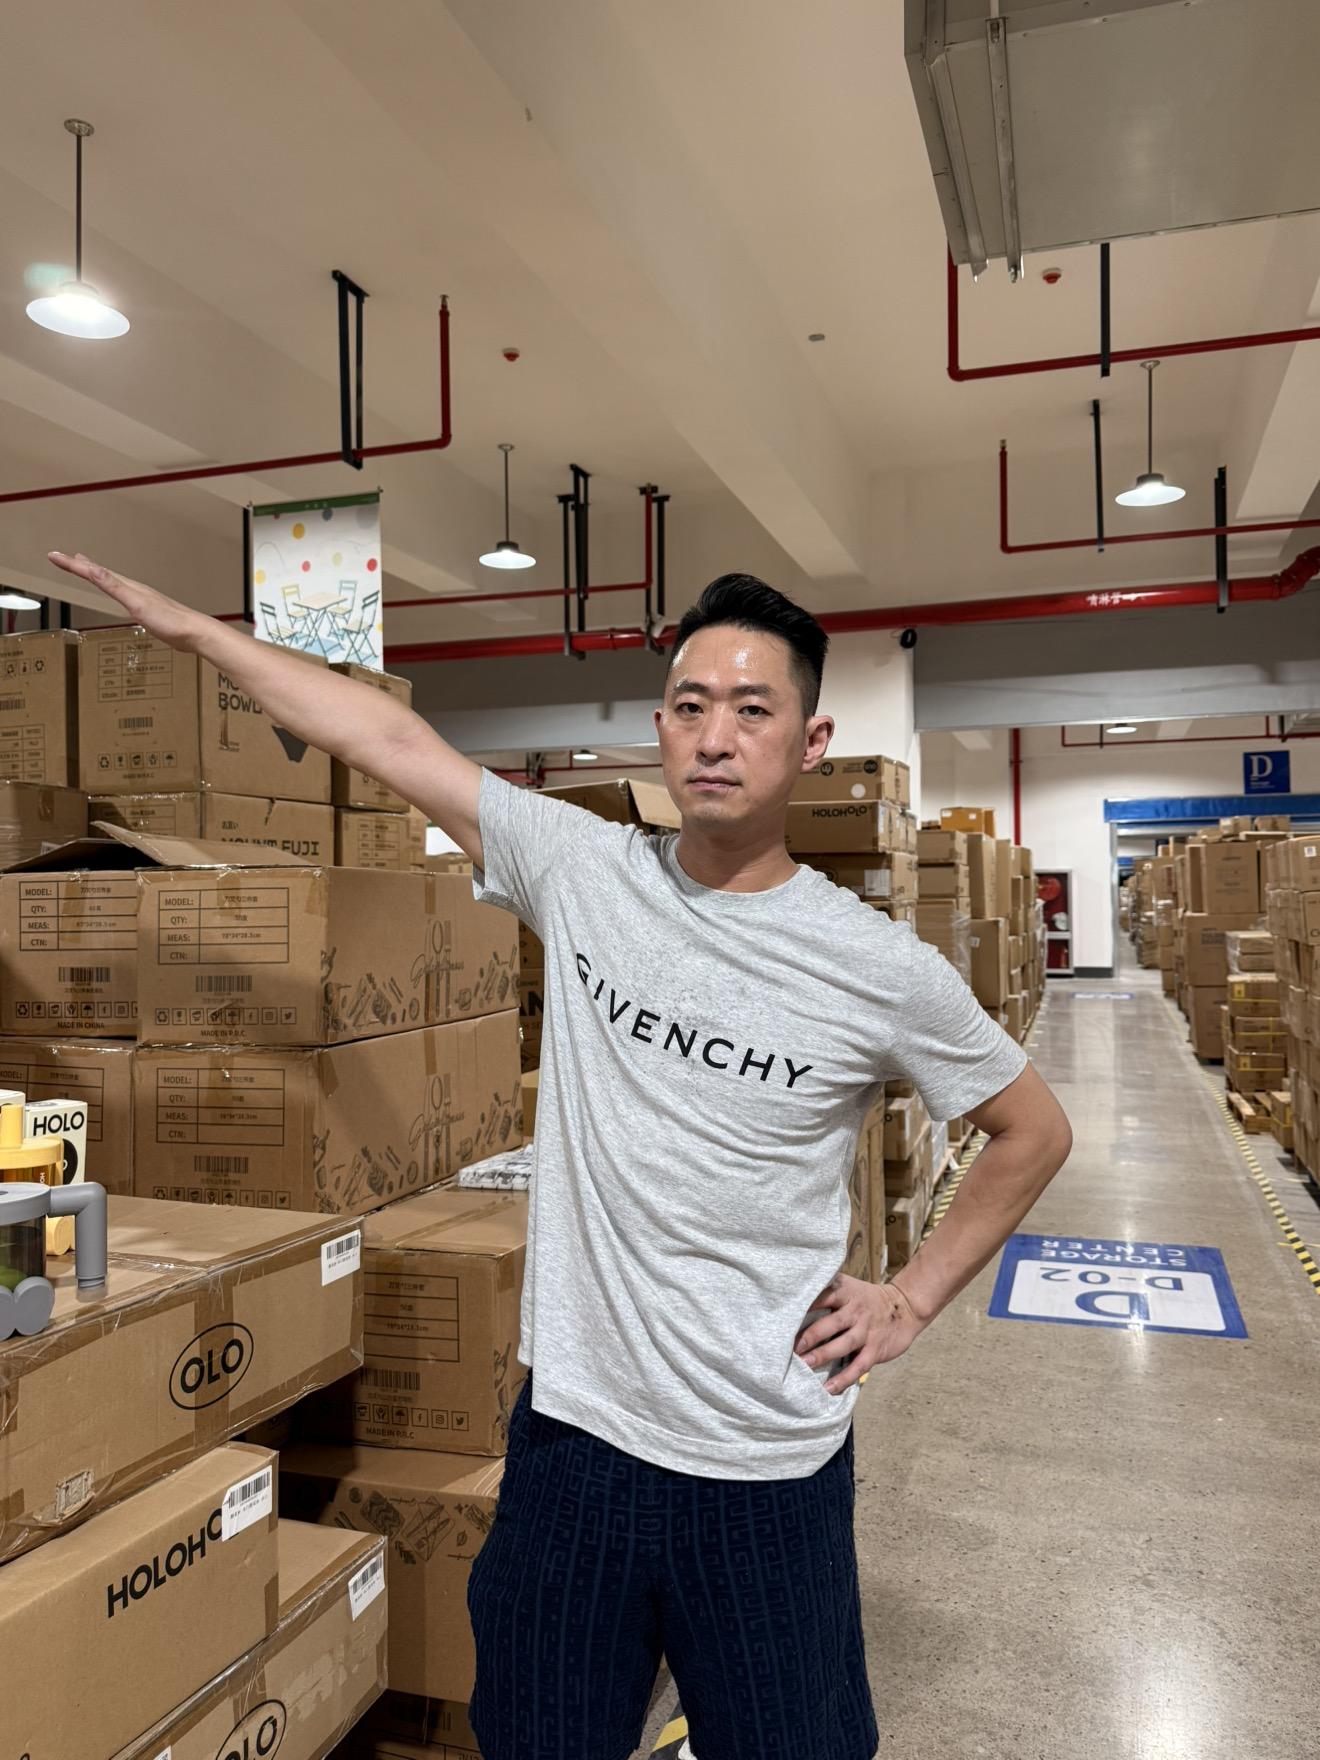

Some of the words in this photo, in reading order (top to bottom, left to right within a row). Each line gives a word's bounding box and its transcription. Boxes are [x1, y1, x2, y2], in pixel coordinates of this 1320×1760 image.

[1250, 755, 1273, 777] D
[811, 805, 867, 818] HOLOHOLO
[282, 840, 319, 856] FUJI
[25, 888, 52, 896] MODEL:
[165, 898, 194, 906] MODEL:
[31, 905, 47, 914] QTY:
[170, 916, 188, 925] QTY:
[30, 938, 47, 946] CTN:
[167, 933, 191, 942] MEAS:
[169, 951, 187, 960] CTN:
[576, 952, 814, 1089] GIVENCHY
[57, 1021, 75, 1029] MADE
[76, 1021, 83, 1029] IN
[84, 1021, 105, 1030] CHINA
[201, 1029, 218, 1037] MADE
[220, 1029, 228, 1037] IN
[163, 1076, 192, 1084] MODEL:
[169, 1094, 186, 1103] QTY:
[165, 1112, 189, 1120] MEAS:
[33, 1111, 85, 1136] HOLO
[168, 1130, 186, 1138] CTN:
[1042, 1239, 1185, 1257] CENTER
[1041, 1249, 1187, 1267] STORAGE
[1039, 1266, 1184, 1292] D-02
[1075, 1290, 1151, 1321] D
[180, 1337, 245, 1394] OLO
[366, 1427, 386, 1437] MADE
[107, 1507, 239, 1619] HOLOHO
[225, 1715, 278, 1760] LO
